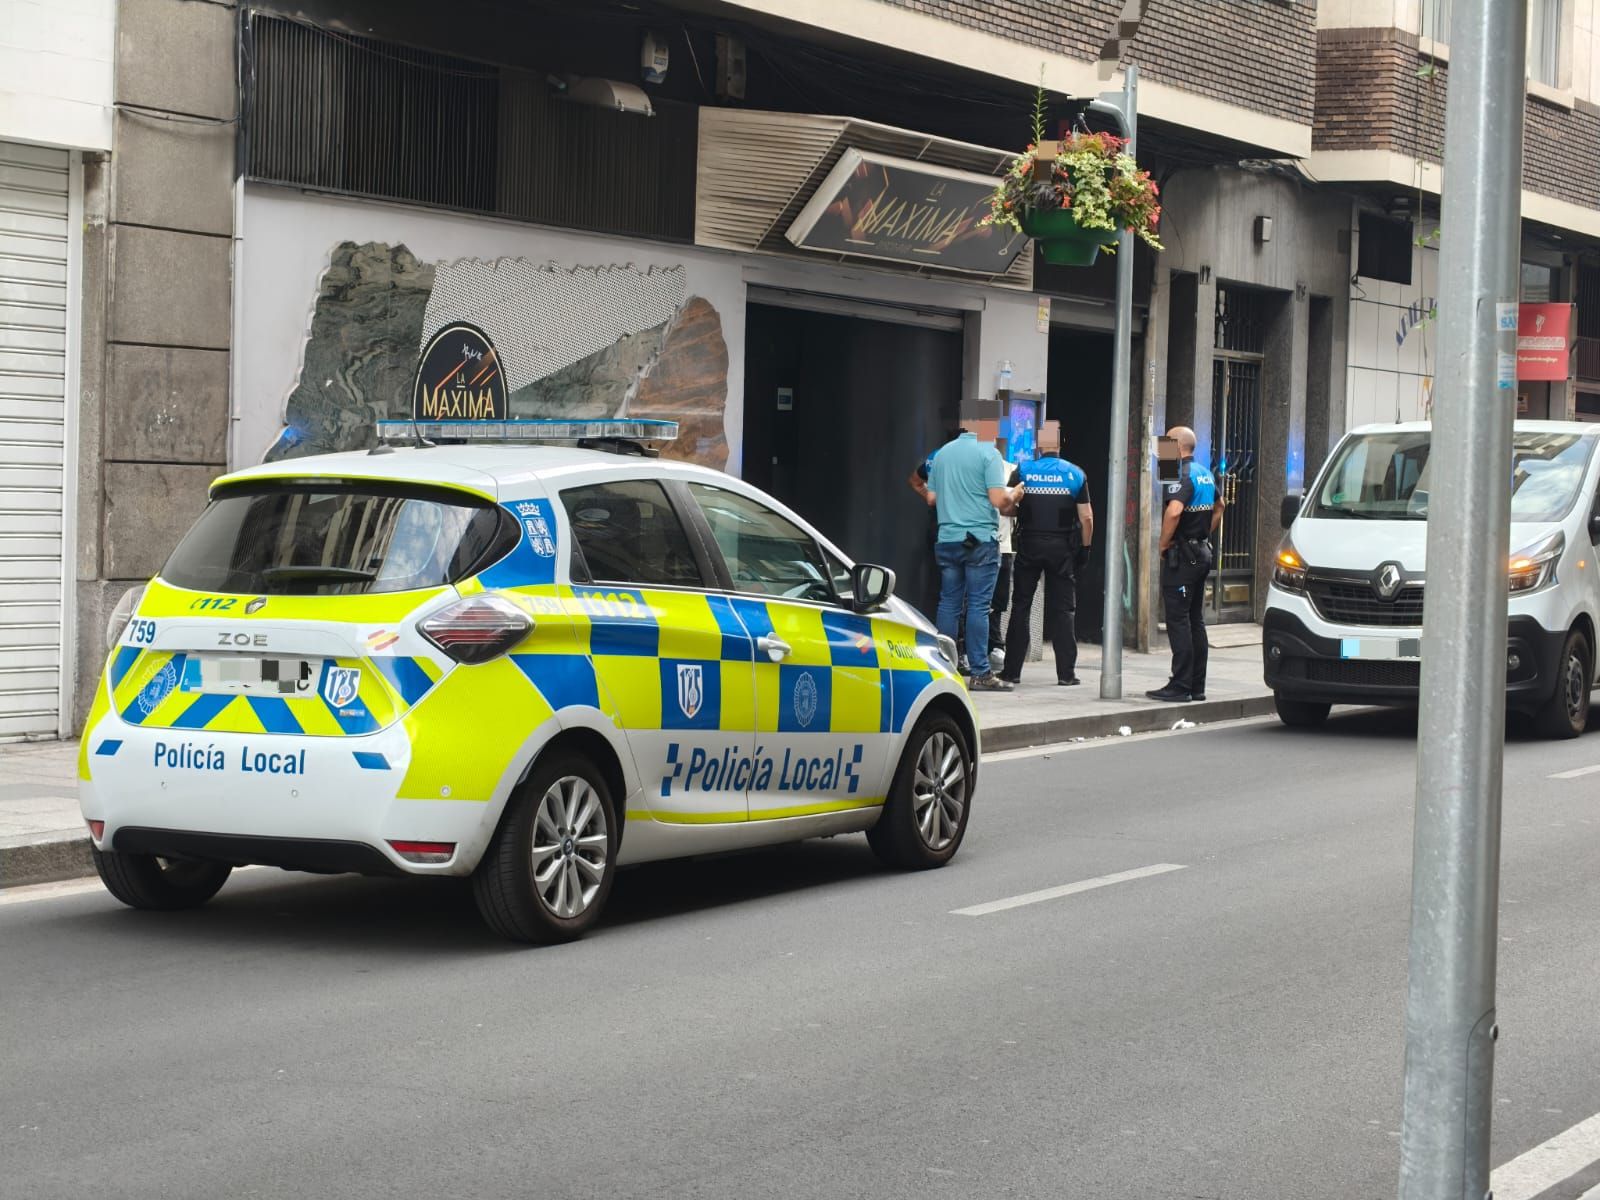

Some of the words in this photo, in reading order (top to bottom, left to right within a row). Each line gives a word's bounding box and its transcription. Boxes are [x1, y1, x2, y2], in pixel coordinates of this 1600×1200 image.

[929, 183, 947, 196] LA
[854, 196, 968, 245] MAXIMA
[456, 372, 466, 384] LA
[423, 384, 495, 418] MAXIMA
[1026, 473, 1063, 483] POLICIA
[130, 620, 156, 644] 759
[218, 632, 268, 647] ZOE
[154, 743, 225, 770] Policía
[241, 746, 306, 775] Local
[684, 745, 774, 792] Policía
[778, 747, 843, 791] Local
